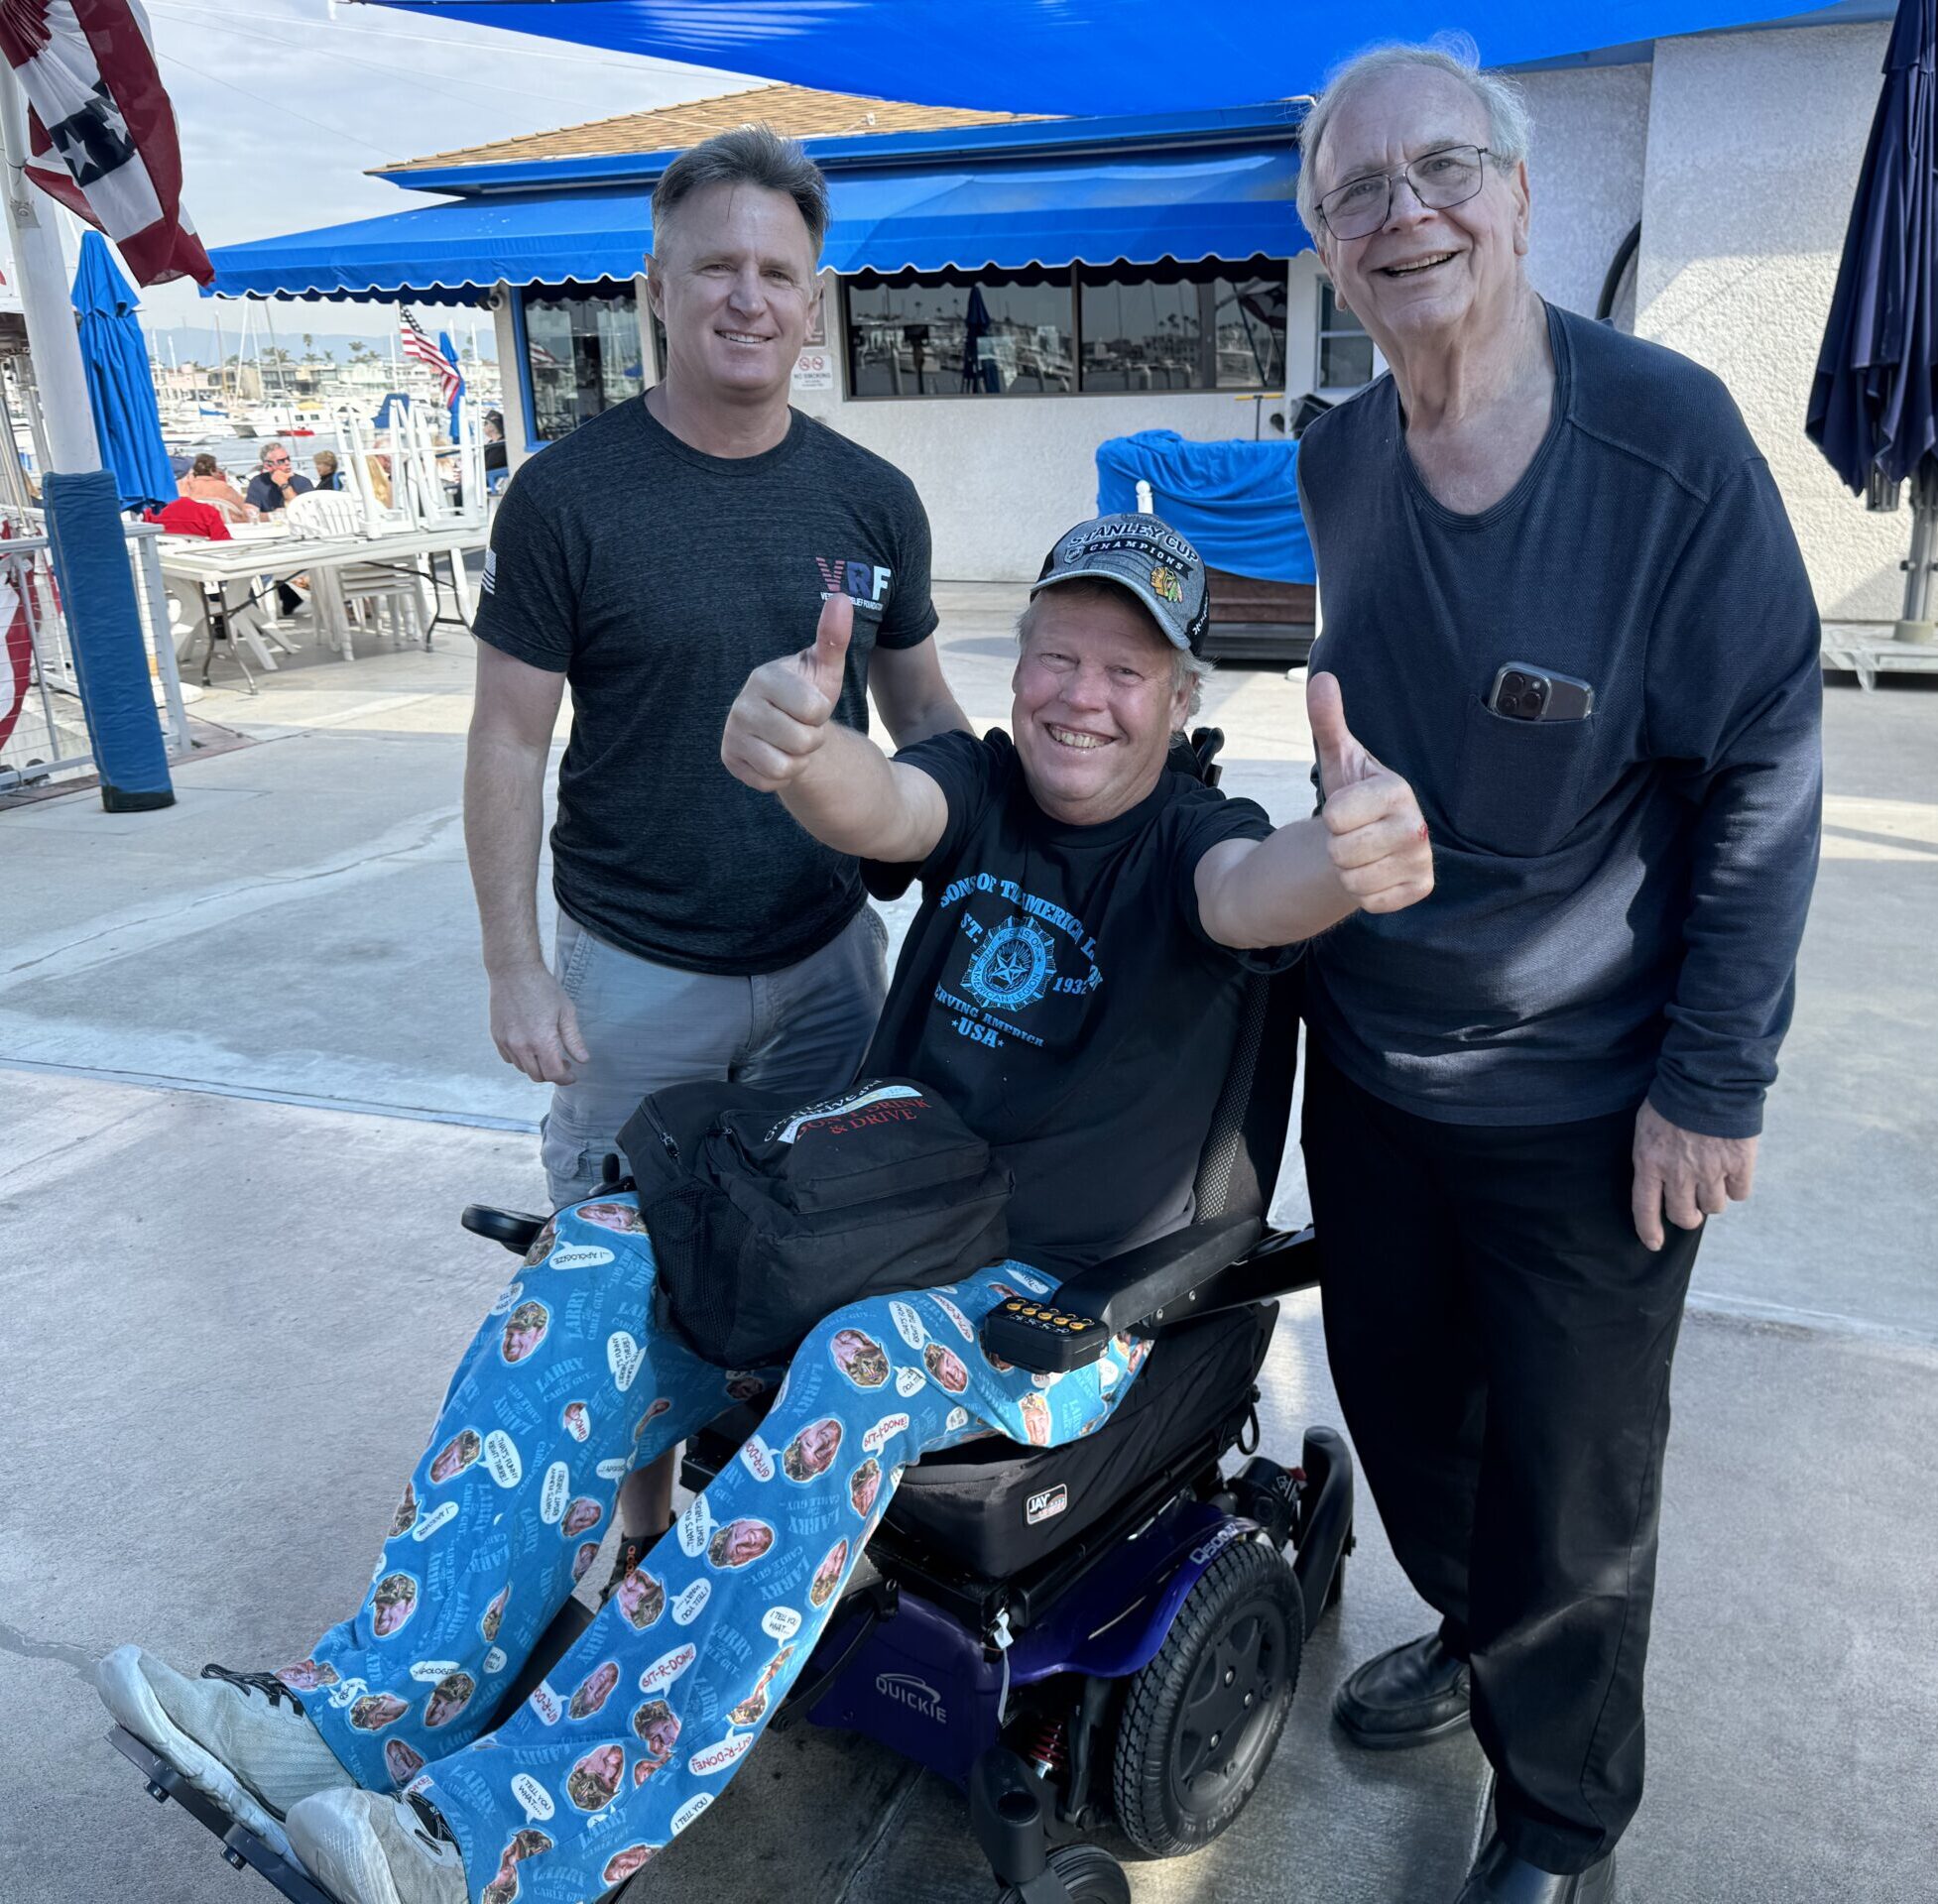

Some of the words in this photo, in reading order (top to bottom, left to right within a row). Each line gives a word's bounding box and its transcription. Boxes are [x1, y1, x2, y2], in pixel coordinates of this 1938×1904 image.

[1068, 523, 1165, 546] STANLEY
[1163, 535, 1198, 562] CUP
[1090, 540, 1183, 569] CHAMPIONS
[816, 556, 892, 601] VRF
[976, 873, 997, 892] OF
[958, 1017, 999, 1047] USA
[850, 1109, 917, 1129] DRIVE
[565, 1289, 588, 1339] LARRY
[536, 1358, 585, 1393] LARRY
[494, 1396, 533, 1436] LARRY
[506, 1457, 519, 1480] FUNNY
[1030, 1493, 1050, 1513] JAY
[788, 1506, 841, 1536] LARRY
[760, 1554, 811, 1601] LARRY
[681, 1606, 694, 1621] YOU
[694, 1591, 707, 1606] TELL
[775, 1611, 787, 1622] TELL
[642, 1647, 694, 1688] GIT-R-DONE!
[876, 1676, 947, 1725] QUICKIE
[524, 1780, 539, 1797] TELL
[538, 1795, 551, 1811] YOU
[678, 1811, 694, 1826] TELL
[692, 1797, 708, 1813] YOU
